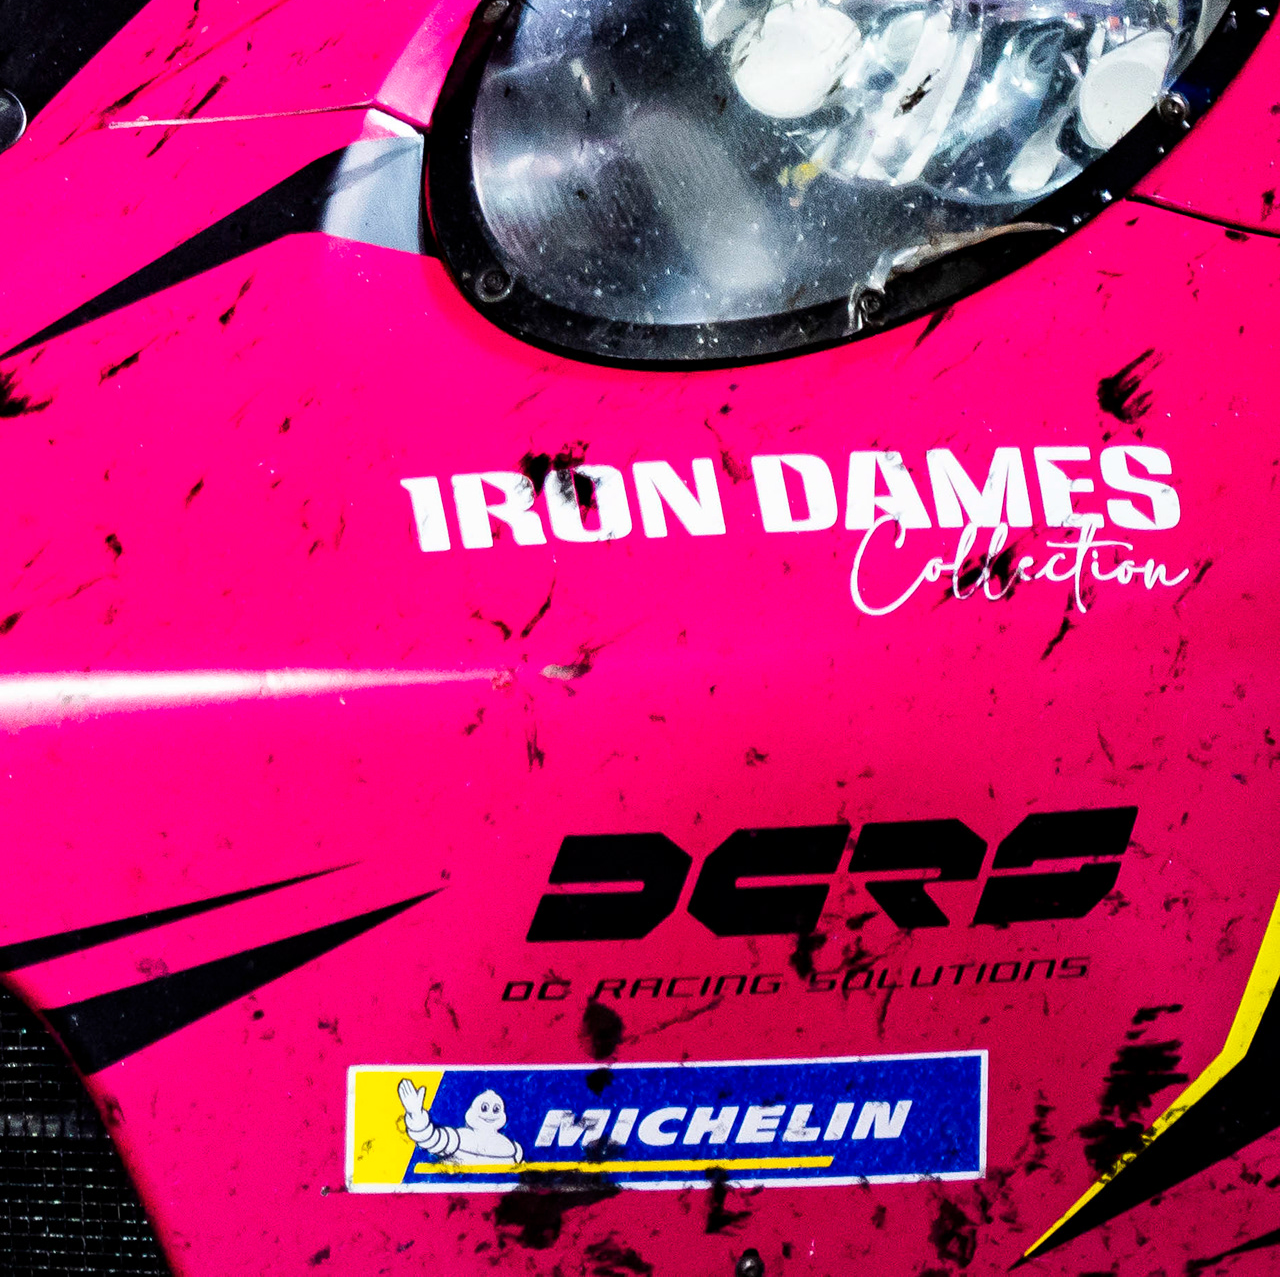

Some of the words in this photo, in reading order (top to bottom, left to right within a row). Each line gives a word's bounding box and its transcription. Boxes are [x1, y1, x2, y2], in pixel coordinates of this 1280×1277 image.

[401, 458, 726, 552] IRON
[743, 445, 1182, 532] DAMES
[849, 515, 1190, 616] Collection
[526, 806, 1139, 943] DCRS
[501, 977, 570, 1003] DC
[591, 971, 781, 1001] RACING
[806, 956, 1090, 995] SOLUTIONS
[535, 1100, 913, 1148] MICHELIN
